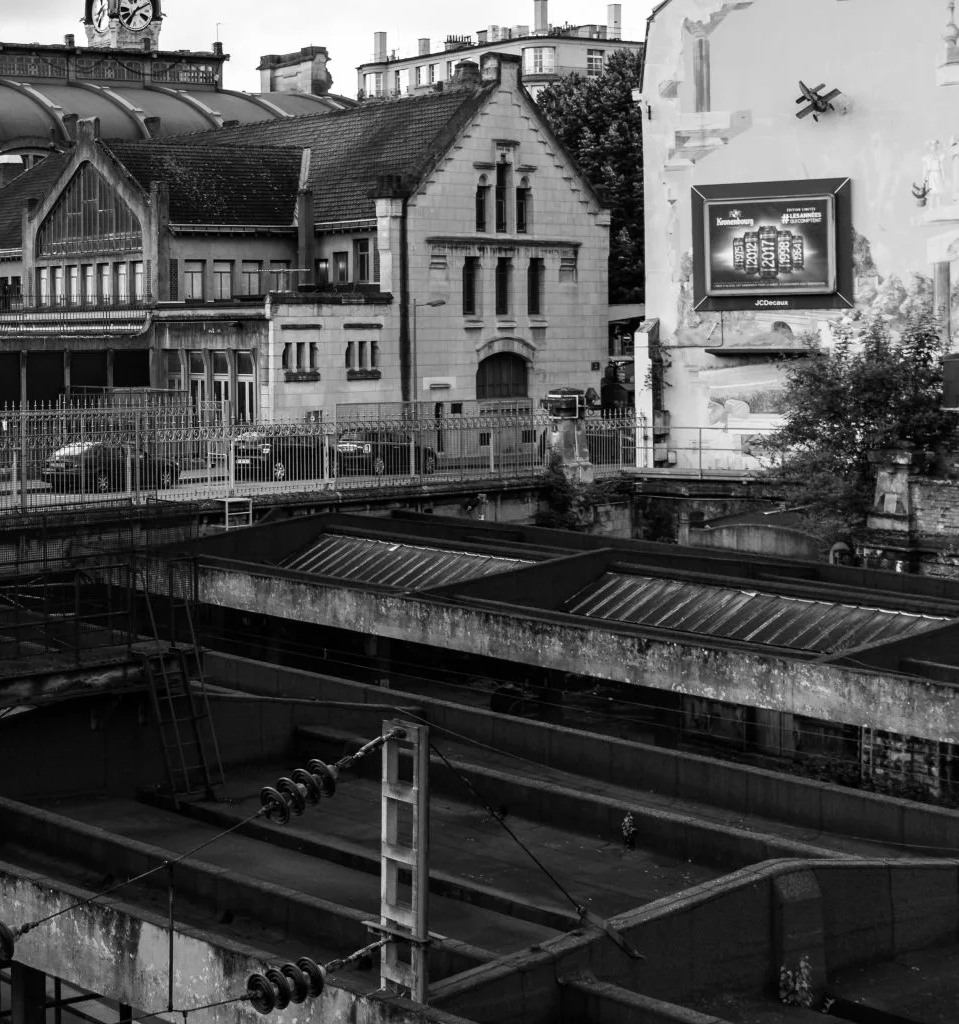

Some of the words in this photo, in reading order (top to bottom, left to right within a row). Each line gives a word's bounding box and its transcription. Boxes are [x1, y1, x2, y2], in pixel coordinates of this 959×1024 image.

[715, 217, 754, 226] Kronenbourg
[746, 242, 757, 265] 2012
[761, 239, 775, 268] 2017
[779, 241, 791, 264] 1998
